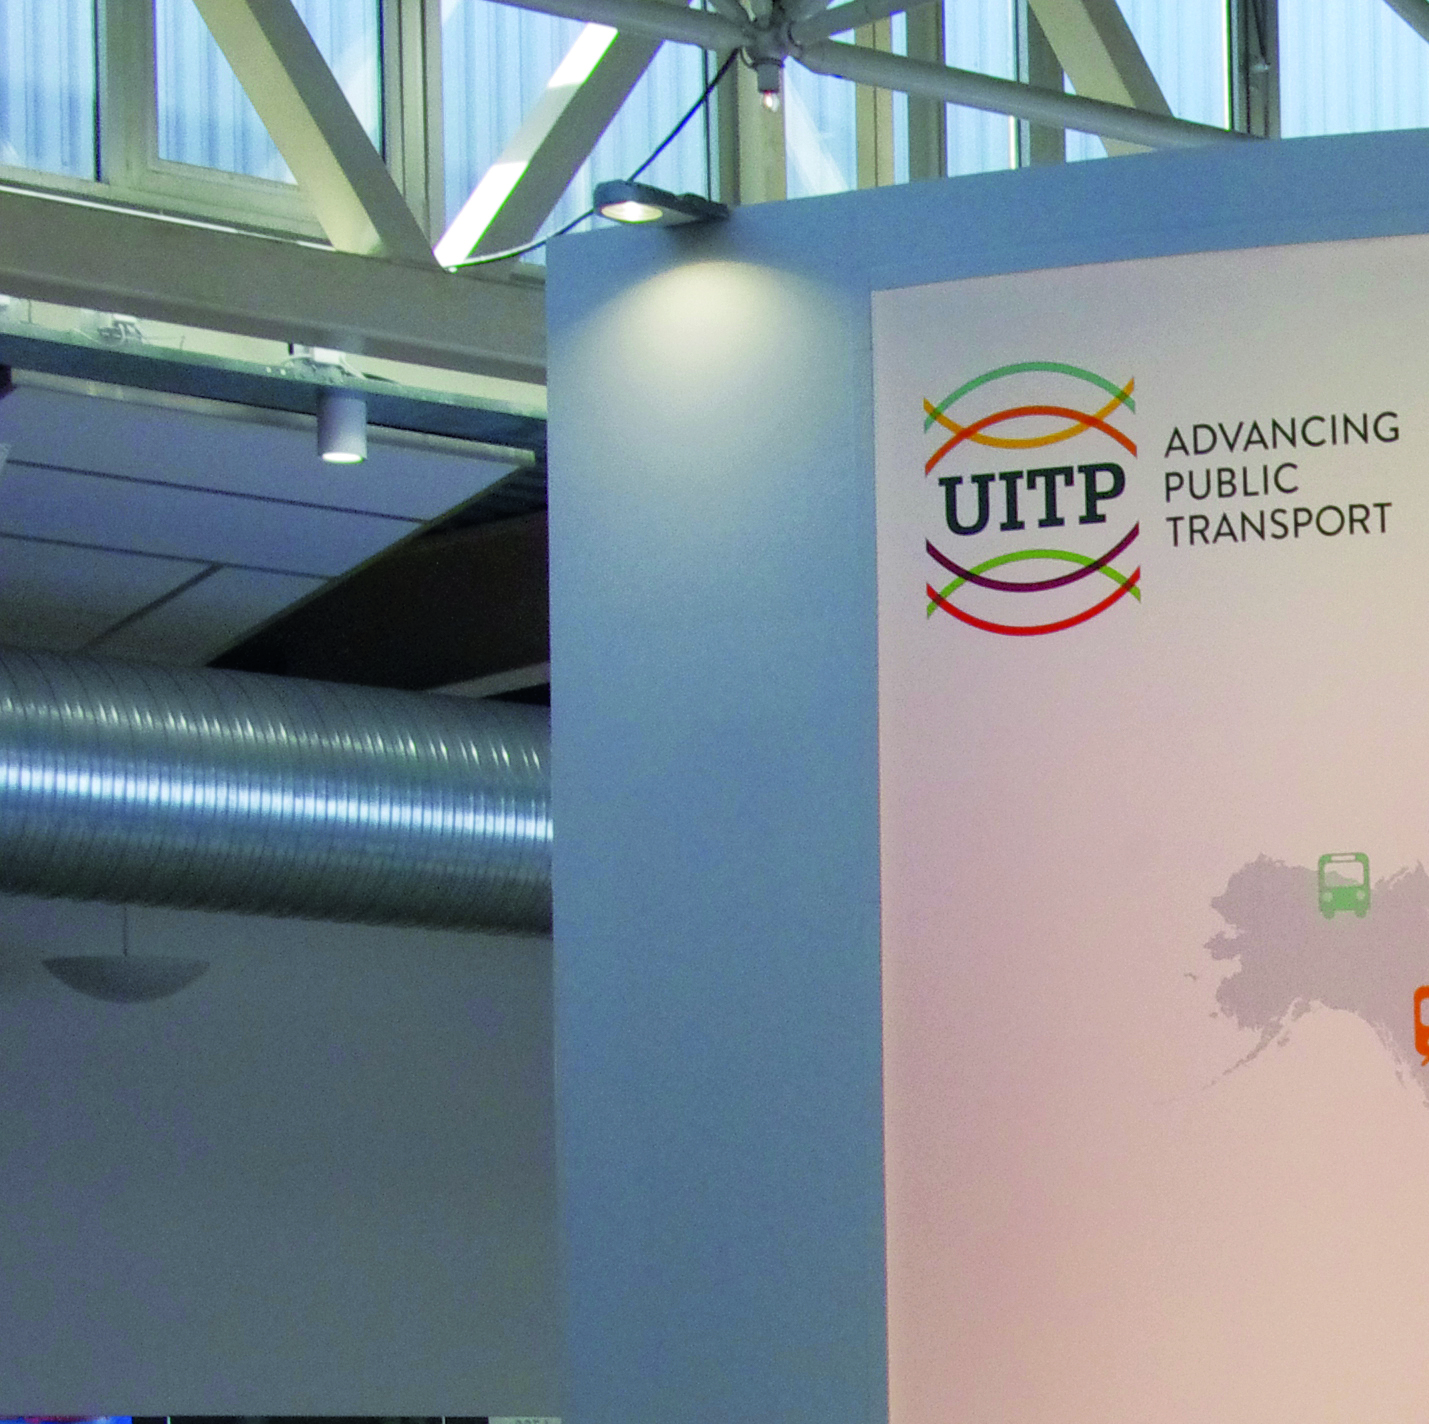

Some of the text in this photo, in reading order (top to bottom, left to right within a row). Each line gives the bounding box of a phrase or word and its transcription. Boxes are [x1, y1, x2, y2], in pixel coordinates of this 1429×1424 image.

[1165, 411, 1400, 458] ADVANCING
[938, 462, 1126, 537] UITP
[1165, 462, 1299, 502] PUBLIC
[1166, 502, 1393, 547] TRANSPORT
